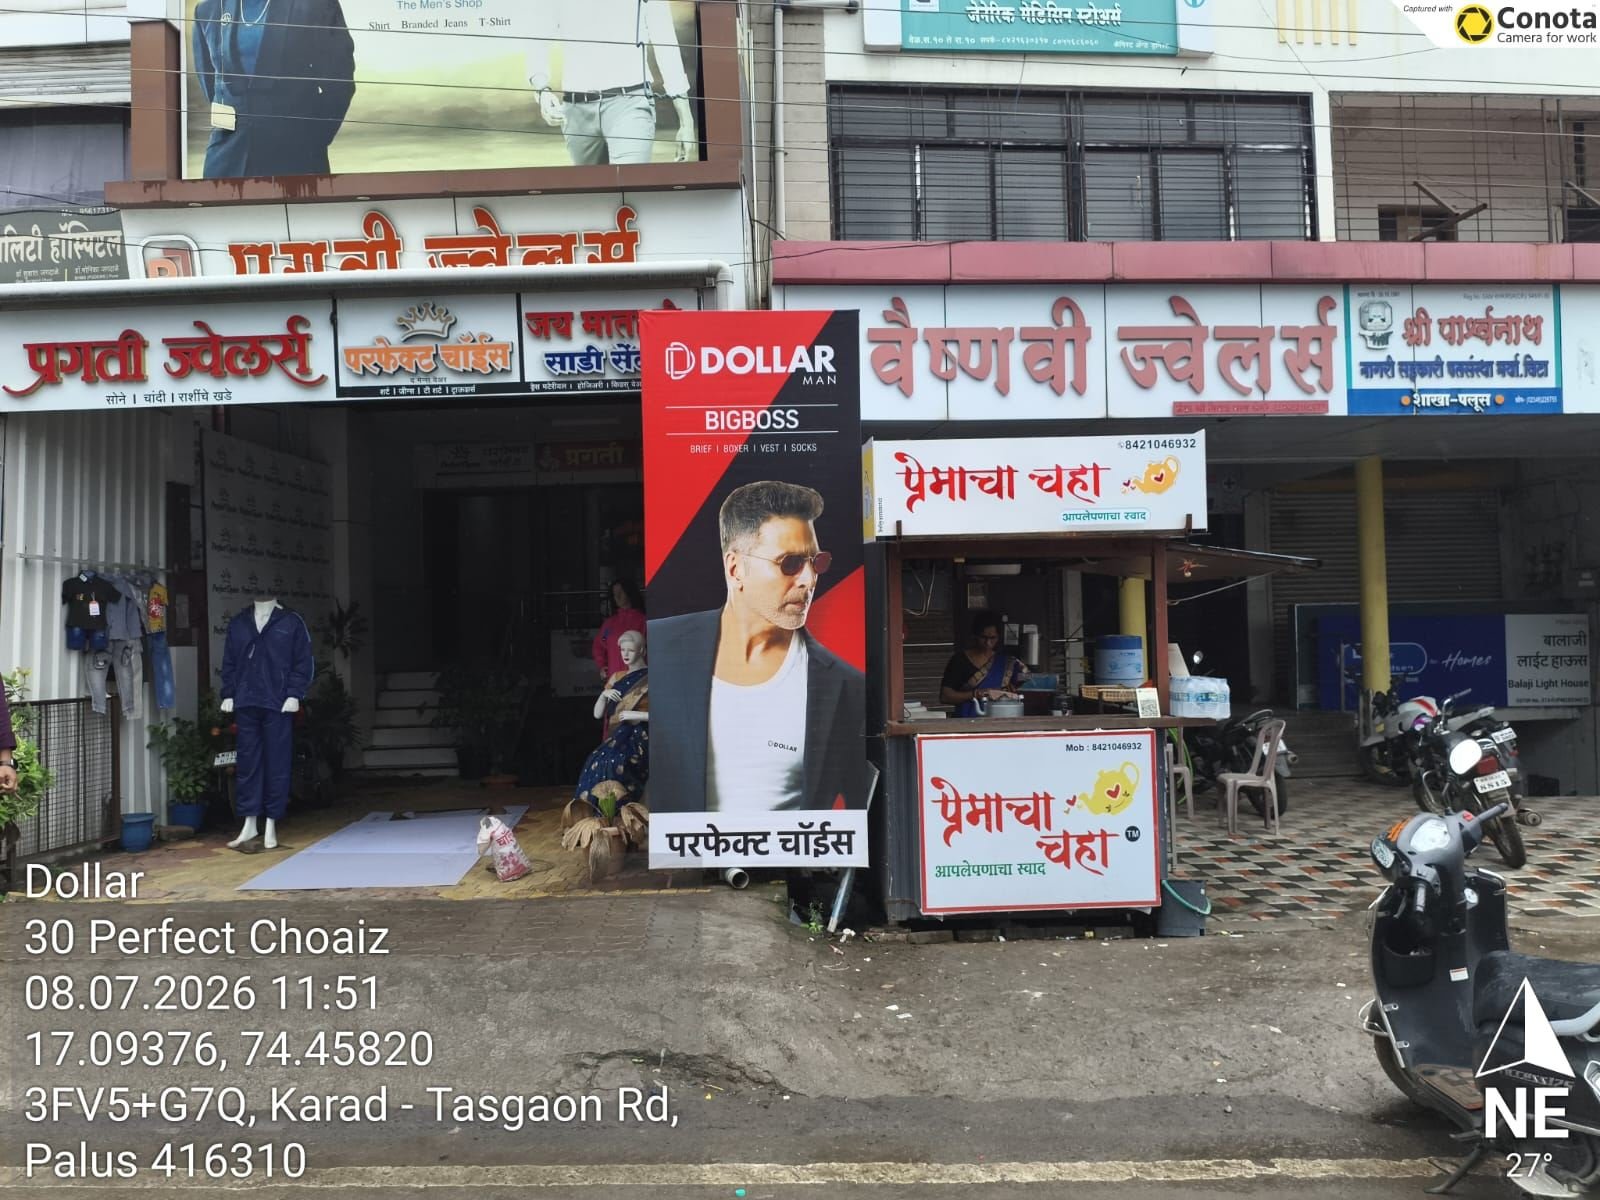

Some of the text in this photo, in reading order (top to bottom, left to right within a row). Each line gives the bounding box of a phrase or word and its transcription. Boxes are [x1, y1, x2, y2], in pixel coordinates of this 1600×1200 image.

[396, 0, 483, 10] The Men's Shop
[965, 0, 1016, 23] जेनेरिक
[368, 16, 512, 31] Shirt Branded Jeans T-Shirt
[48, 220, 122, 264] हॉस्पिटल
[525, 311, 574, 340] जय
[1401, 305, 1544, 347] श्री पार्श्वनाथ
[2, 314, 329, 397] प्रगती ज्वेलर्स
[343, 331, 514, 376] परफेक्ट चॉईस
[867, 295, 1338, 398] वैष्णवी ज्वेलर्स
[543, 345, 605, 376] साडी
[701, 345, 837, 375] DOLLAR
[1359, 354, 1396, 379] नागरी
[802, 375, 837, 385] MAN
[105, 387, 233, 405] सोने चांदी राशींचे खडे
[705, 409, 800, 430] BIGBOSS
[690, 442, 818, 454] BRIEF BOXER VEST SOCKS
[1124, 437, 1198, 451] 8421046932
[894, 451, 1020, 514] प्रेमाचा
[1027, 461, 1112, 504] चहा
[1062, 509, 1148, 522] आपलेपणाचा स्वाद
[1543, 631, 1588, 648] बालाजी
[1441, 648, 1493, 672] Homes
[1516, 651, 1589, 670] लाईट हाऊस
[1508, 677, 1590, 692] Balaji Light House
[1065, 743, 1085, 752] Mob
[1092, 742, 1143, 752] 8421046932
[930, 776, 1056, 848] प्रेमाचा
[665, 820, 856, 858] परफेक्ट चॉईस
[1127, 829, 1140, 839] TM
[1035, 828, 1120, 877] चहा
[935, 860, 1047, 879] आपलेपणाचा स्वाद
